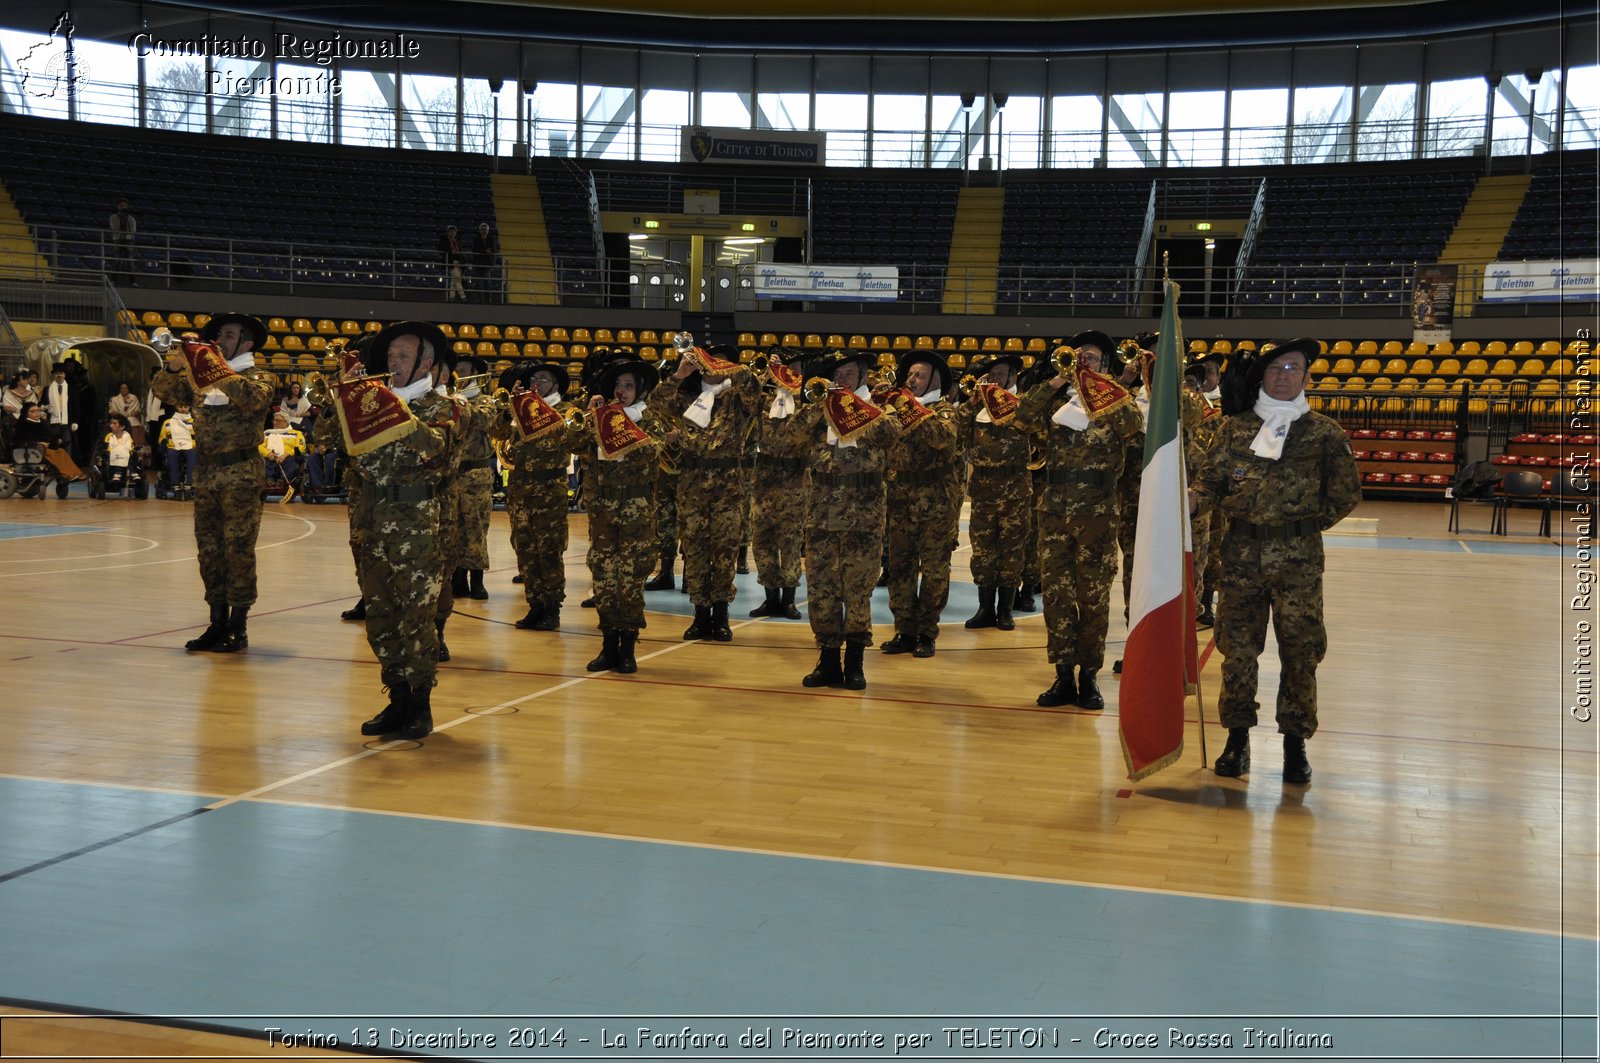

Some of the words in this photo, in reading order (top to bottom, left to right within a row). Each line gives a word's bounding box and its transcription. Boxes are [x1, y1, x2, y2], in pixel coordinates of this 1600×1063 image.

[769, 143, 814, 158] TORINO
[761, 269, 796, 288] Telethon
[809, 270, 844, 289] Telethon
[857, 272, 892, 290] Telethon
[1492, 270, 1535, 291] Telethon
[1550, 268, 1595, 288] Telethon
[845, 413, 870, 429] TORINO
